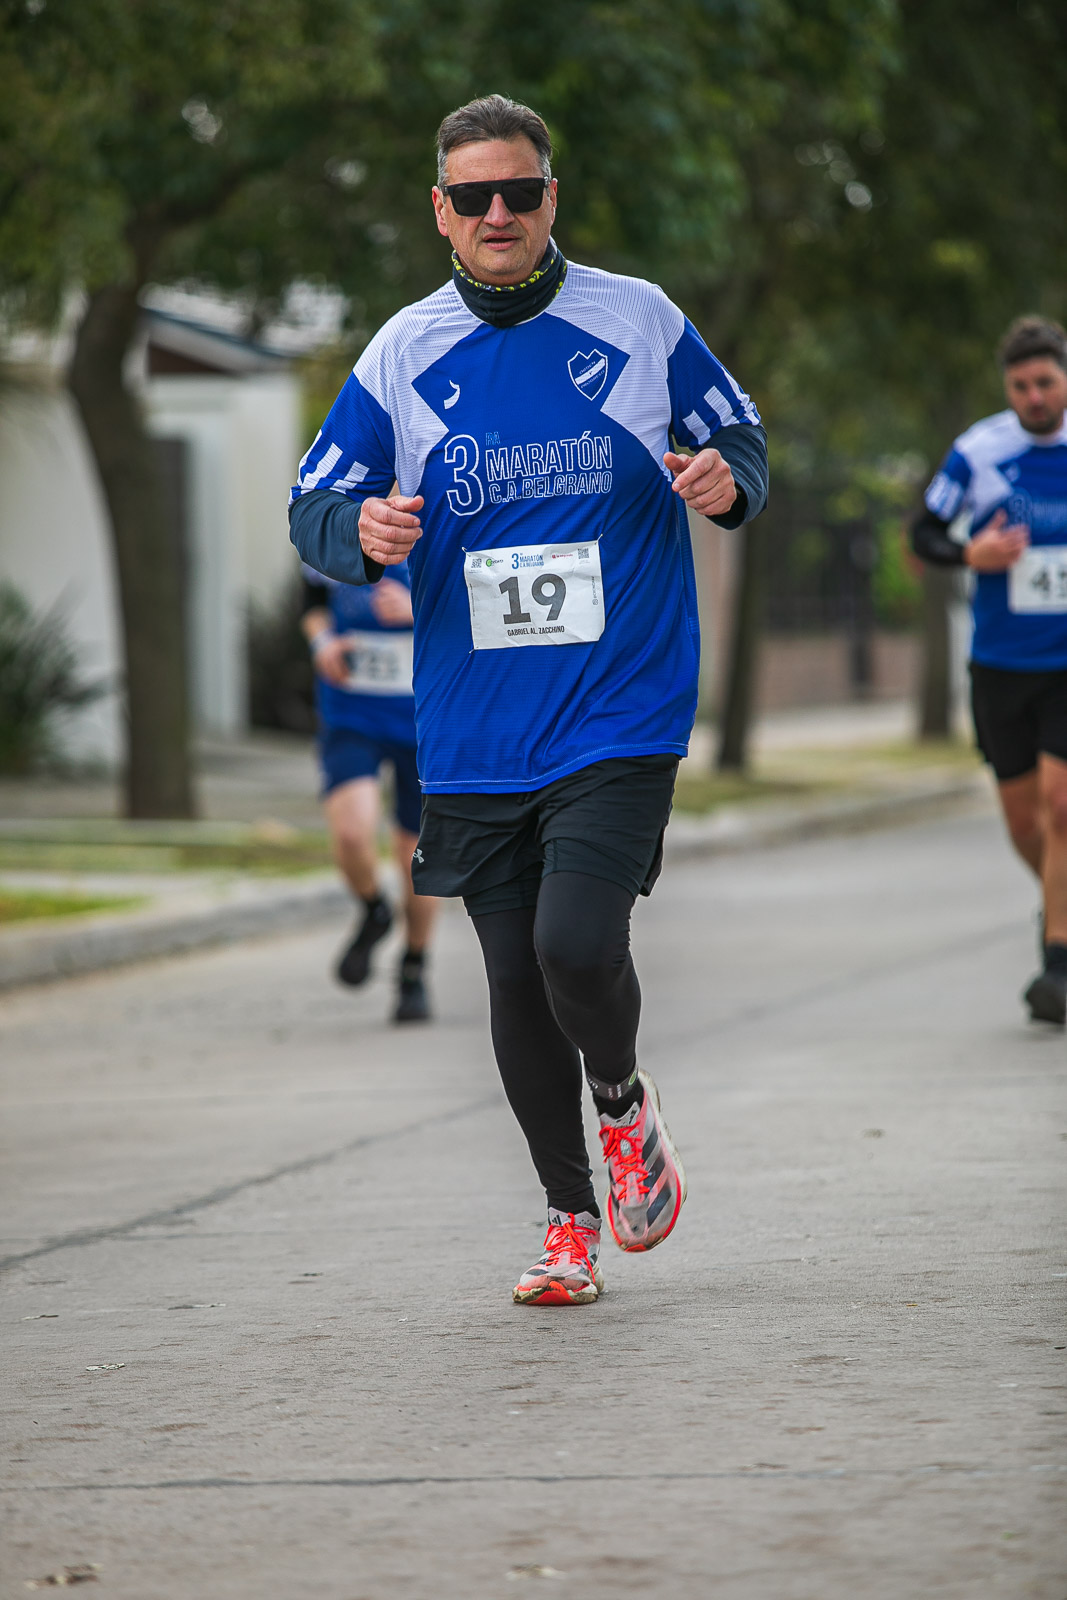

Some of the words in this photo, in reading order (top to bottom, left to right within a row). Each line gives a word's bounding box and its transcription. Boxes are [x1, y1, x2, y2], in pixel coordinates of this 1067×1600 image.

[444, 434, 485, 517] 3
[485, 430, 613, 482] MARATÓN
[511, 552, 519, 570] 3
[498, 573, 567, 625] 19
[507, 627, 530, 637] GABRIEL
[538, 625, 565, 635] ZACCHINO
